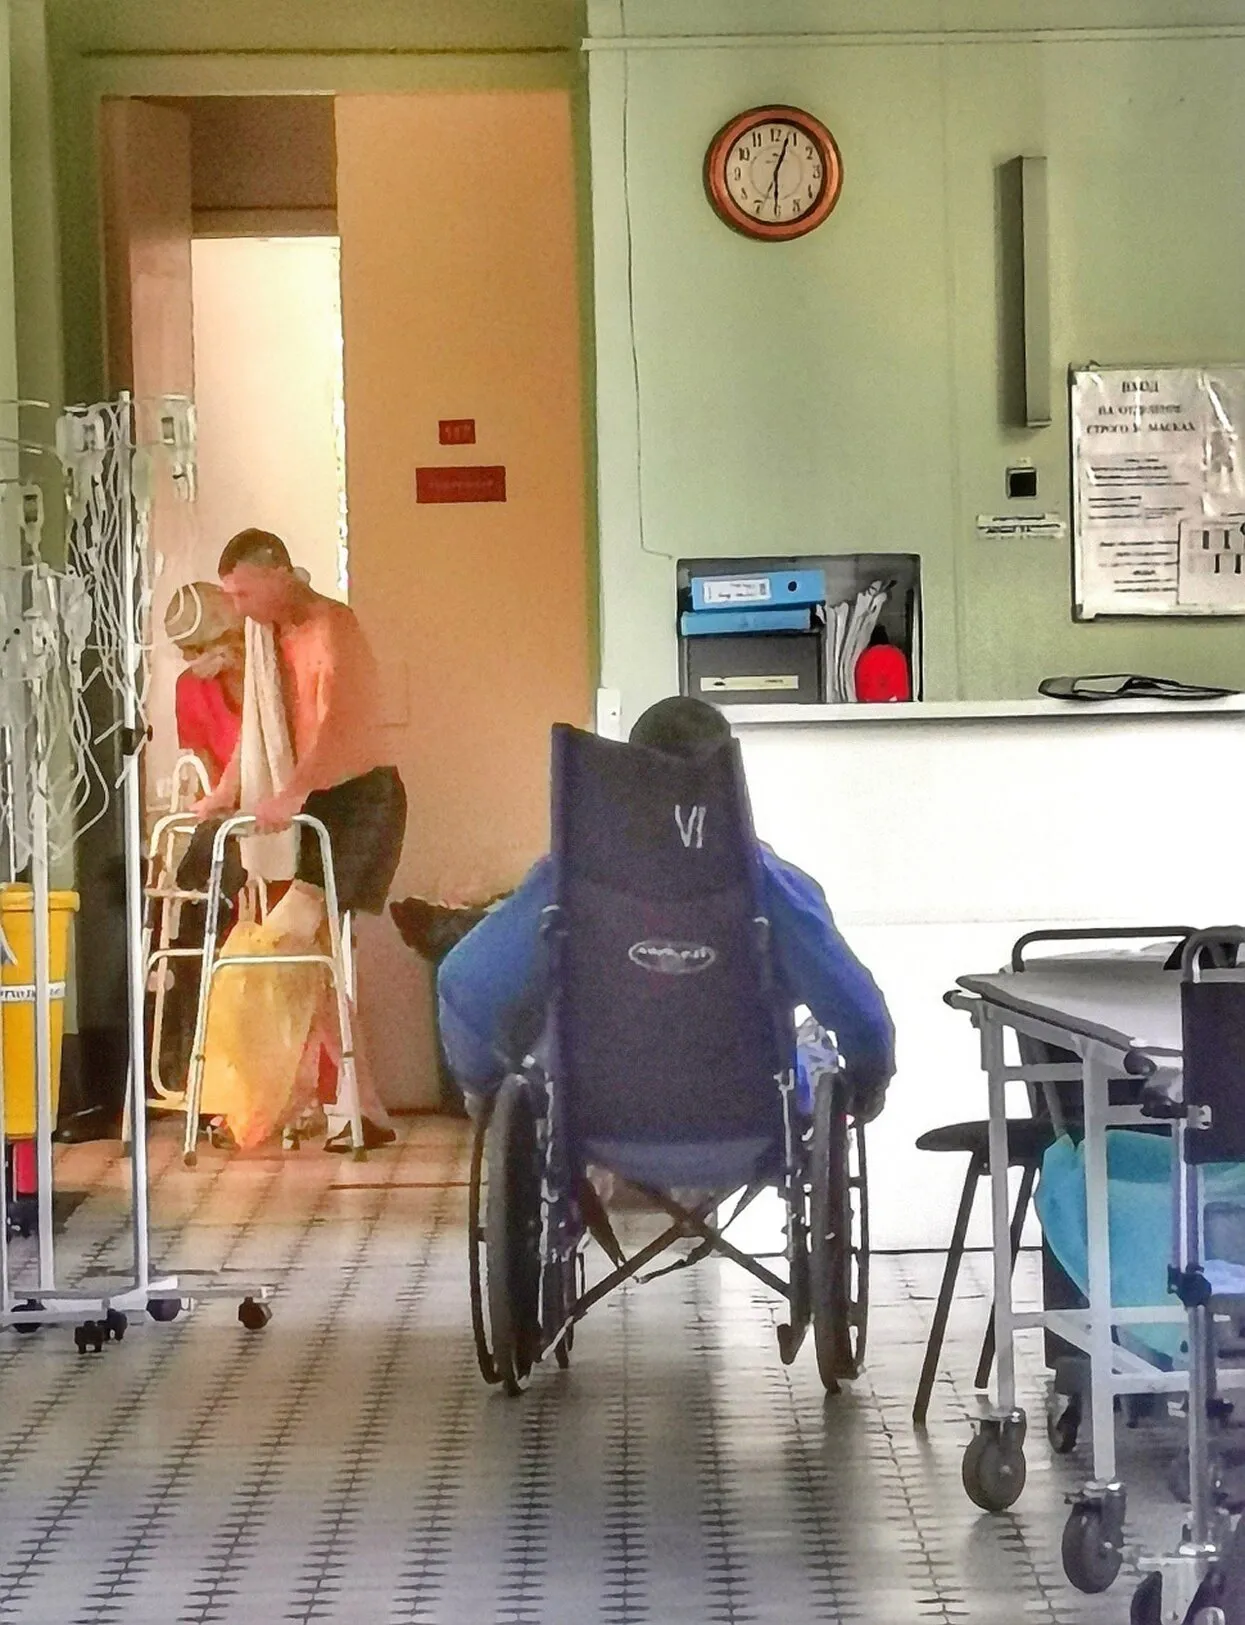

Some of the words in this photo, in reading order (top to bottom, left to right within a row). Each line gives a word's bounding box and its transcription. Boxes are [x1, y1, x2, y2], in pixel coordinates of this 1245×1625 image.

[752, 132, 762, 147] 11
[770, 128, 782, 142] 12
[792, 132, 798, 146] 1
[738, 147, 750, 161] 10
[805, 146, 813, 160] 2
[733, 167, 741, 181] 9
[812, 164, 821, 179] 3
[740, 187, 748, 200] 8
[753, 200, 763, 214] 7
[792, 199, 801, 212] 5
[674, 804, 707, 849] VI
